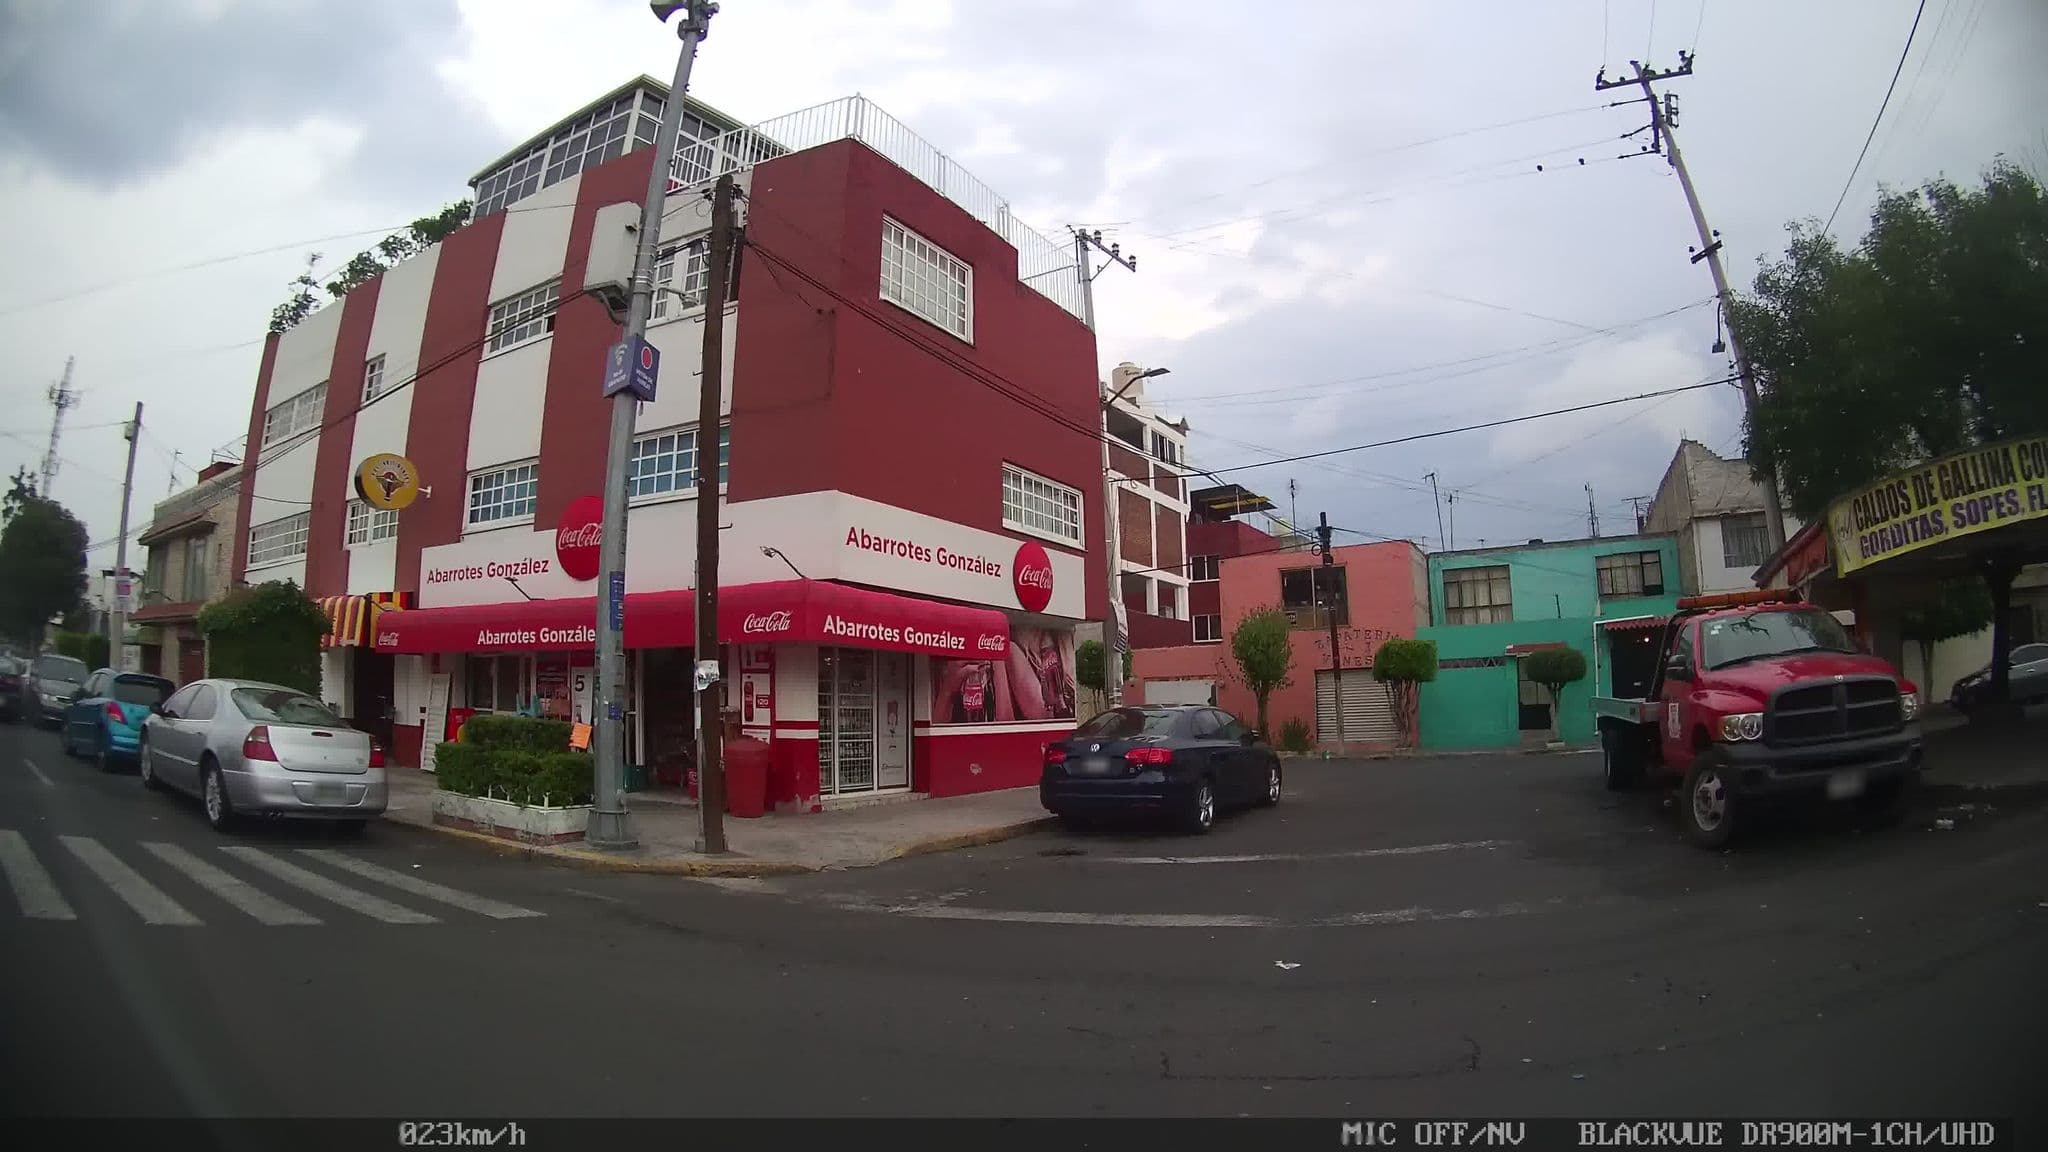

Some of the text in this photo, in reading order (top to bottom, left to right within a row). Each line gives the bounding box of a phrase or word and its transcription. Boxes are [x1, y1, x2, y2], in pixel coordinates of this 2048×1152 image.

[1853, 479, 1912, 532] CALDOS
[1911, 470, 1938, 511] DE
[1937, 447, 2017, 501] GALLINA
[846, 526, 1001, 578] Abarrotes González
[1859, 509, 1949, 560] GORDITAS,
[427, 558, 549, 584] Abarrotes González
[477, 625, 596, 645] Abarrotes Gonzále
[823, 614, 966, 650] Abarrotes González
[575, 674, 585, 692] 5
